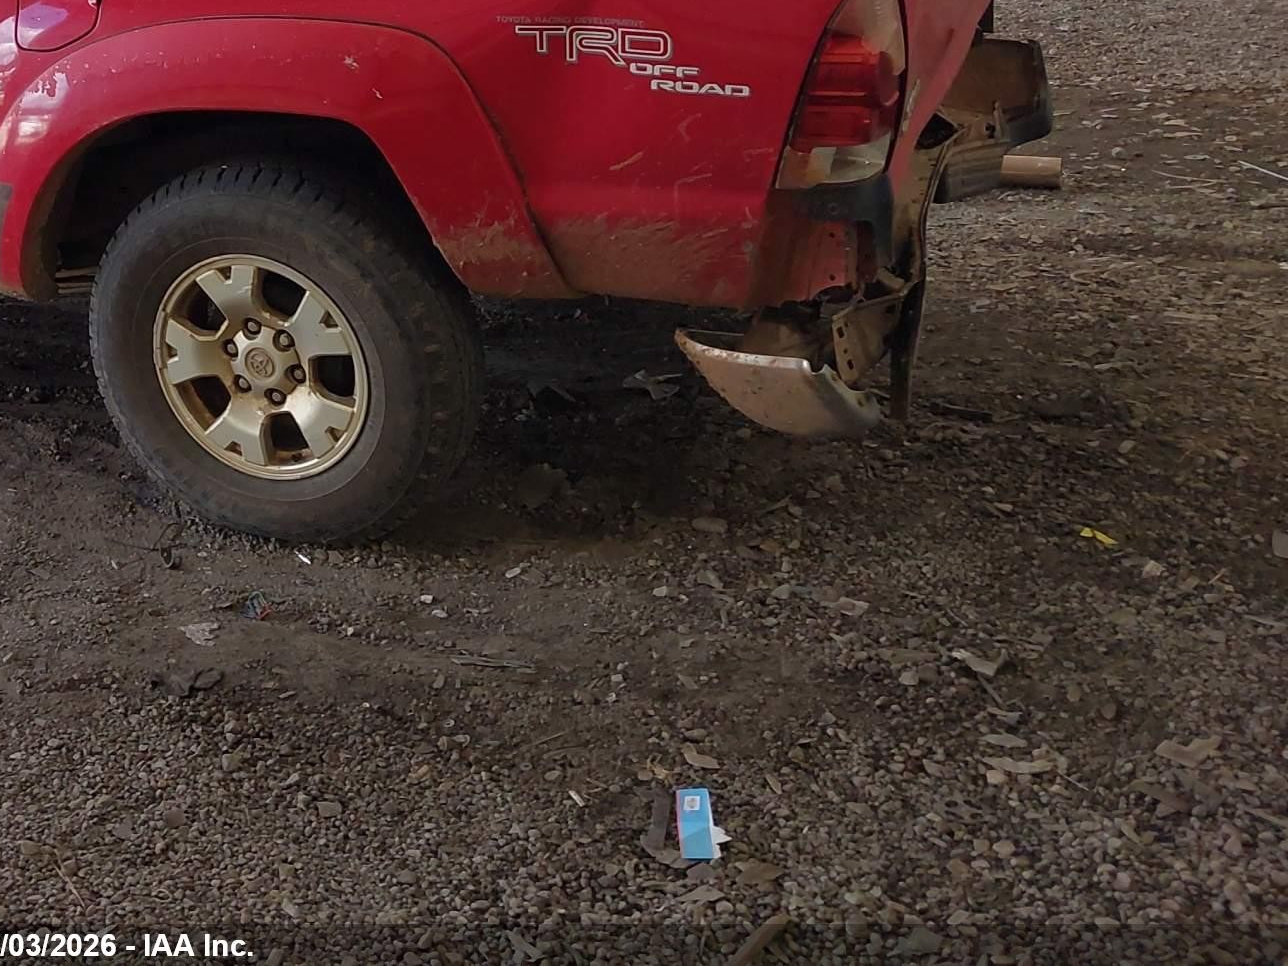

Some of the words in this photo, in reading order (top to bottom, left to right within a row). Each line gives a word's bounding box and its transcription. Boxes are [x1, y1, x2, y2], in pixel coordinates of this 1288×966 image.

[515, 25, 673, 66] TRD
[629, 62, 700, 78] OFF
[651, 79, 751, 97] ROAD
